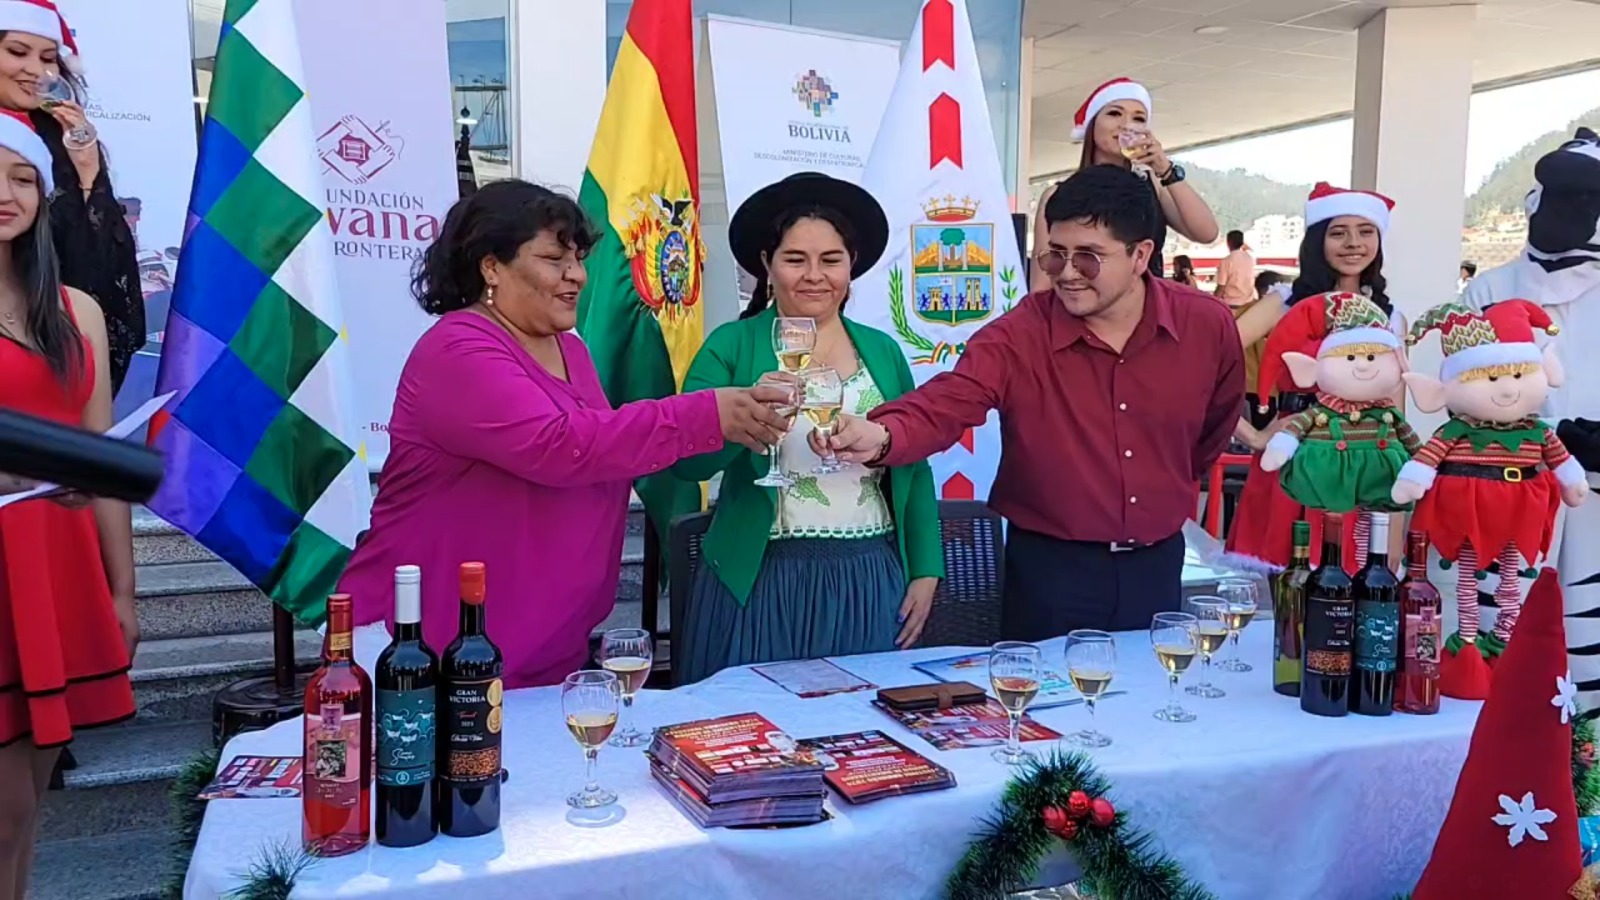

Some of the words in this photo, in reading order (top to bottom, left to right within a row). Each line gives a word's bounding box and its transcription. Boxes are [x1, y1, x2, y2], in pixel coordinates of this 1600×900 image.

[86, 111, 151, 122] RCALIZACIÓN
[788, 124, 851, 143] BOLIVIA
[326, 188, 424, 210] UNDACIÓN
[326, 207, 440, 241] vana
[334, 240, 428, 261] RONTERA
[449, 695, 486, 703] VICTORIA
